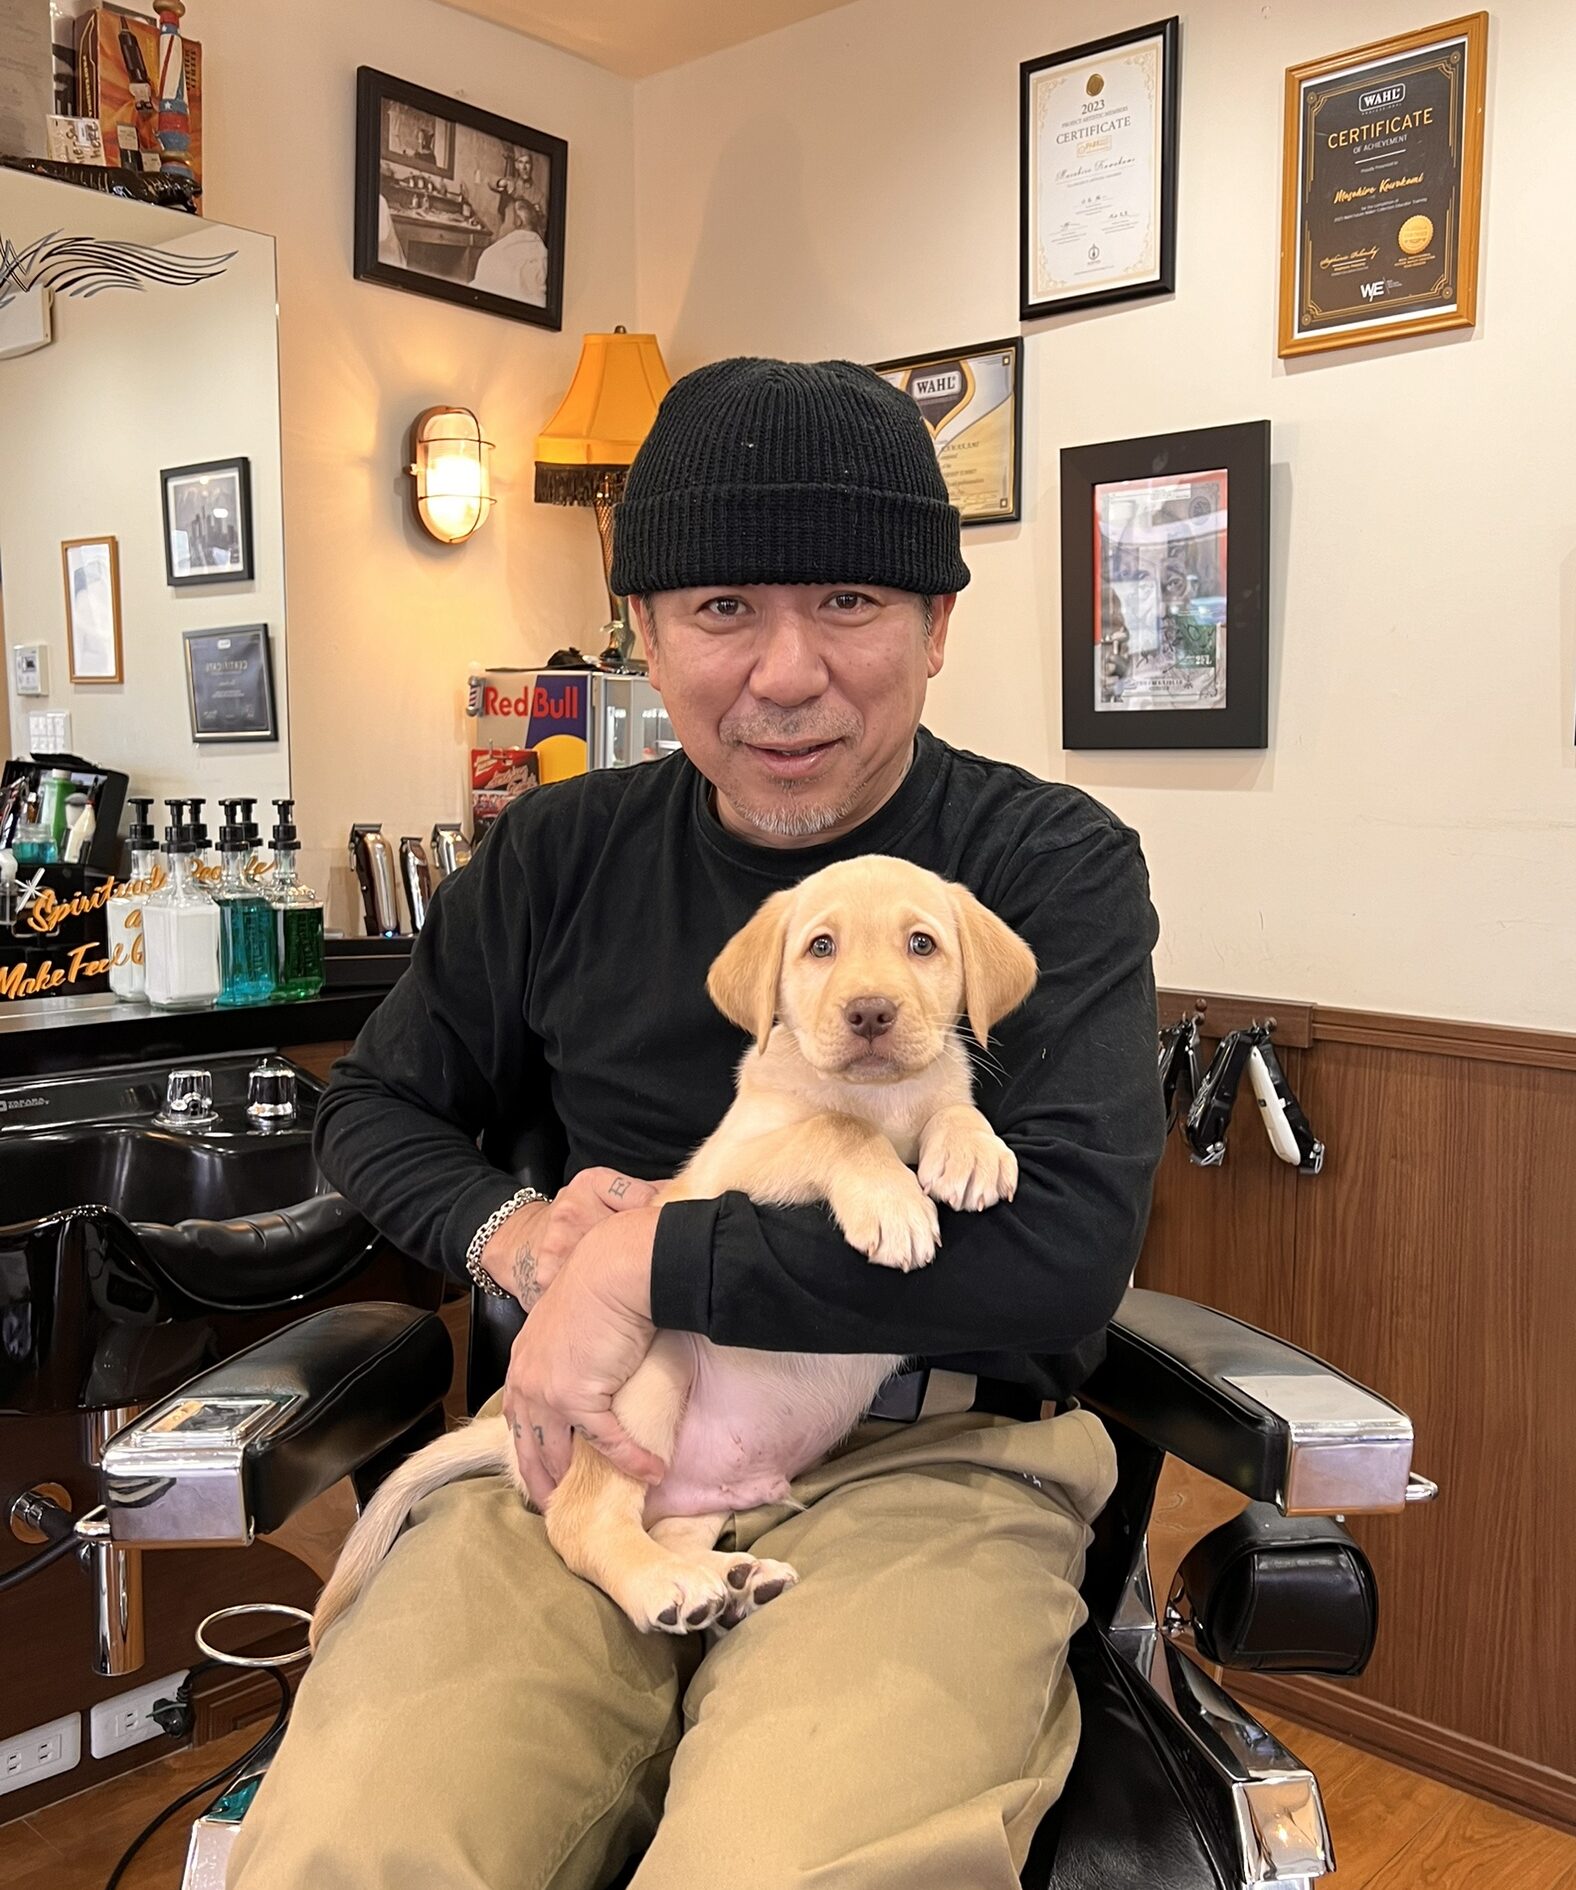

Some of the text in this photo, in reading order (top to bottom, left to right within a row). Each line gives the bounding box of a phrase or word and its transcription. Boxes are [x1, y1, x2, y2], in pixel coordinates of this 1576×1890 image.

[1080, 98, 1105, 115] 2023
[1363, 88, 1401, 107] WAHL
[1055, 116, 1132, 145] CERTIFICATE
[1327, 107, 1433, 149] CERTIFICATE
[1352, 133, 1409, 155] OF ACHIEVEMENT
[916, 376, 955, 394] WAHL
[483, 686, 579, 720] Red Bull
[0, 960, 66, 1000] Make
